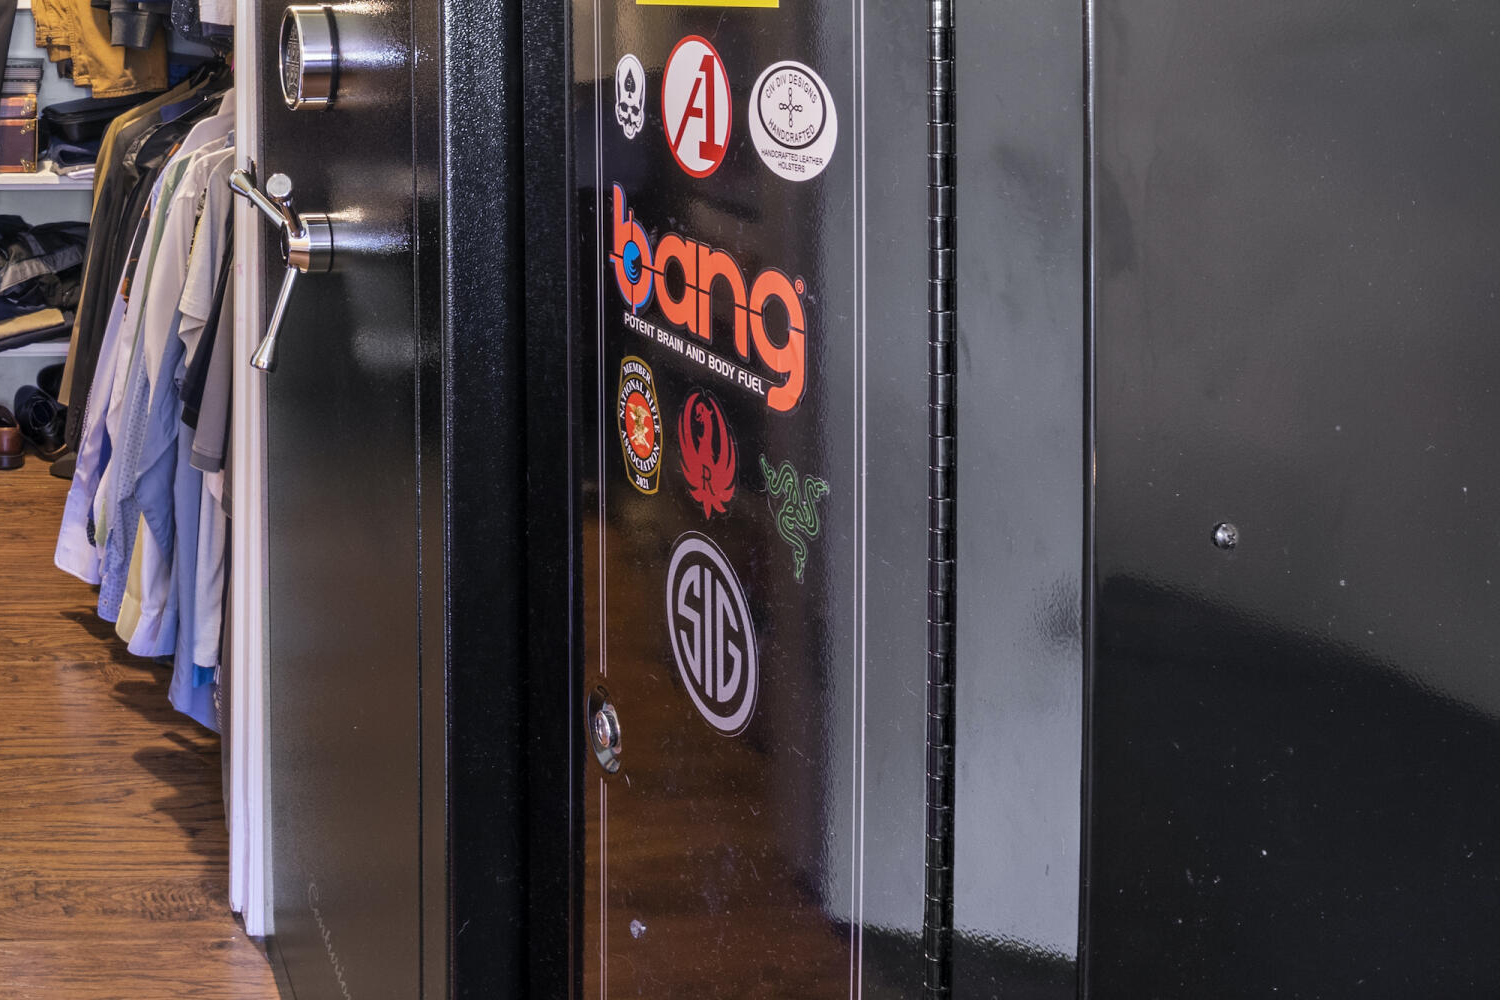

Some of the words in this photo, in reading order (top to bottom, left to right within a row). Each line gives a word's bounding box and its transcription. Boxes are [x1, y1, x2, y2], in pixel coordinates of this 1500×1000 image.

[765, 83, 776, 98] CIV
[788, 73, 818, 103] DESIGNS
[768, 118, 815, 143] HANDCRAFTED
[761, 148, 799, 162] HANDCRAFTED
[799, 154, 823, 166] LEATHER
[778, 161, 805, 173] HOLSTERS
[609, 183, 805, 412] bang
[624, 312, 655, 337] POTENT
[657, 328, 683, 354] BRAIN
[685, 344, 706, 365] AND
[708, 354, 736, 380] BODY
[737, 370, 765, 395] FUEL
[623, 361, 651, 385] MEMBER
[619, 378, 644, 419] NATIONAL
[644, 387, 660, 433] RIFLE
[621, 430, 660, 472] ASSOCIATION
[635, 474, 650, 490] 2021
[702, 463, 714, 495] R
[677, 564, 742, 704] SIG
